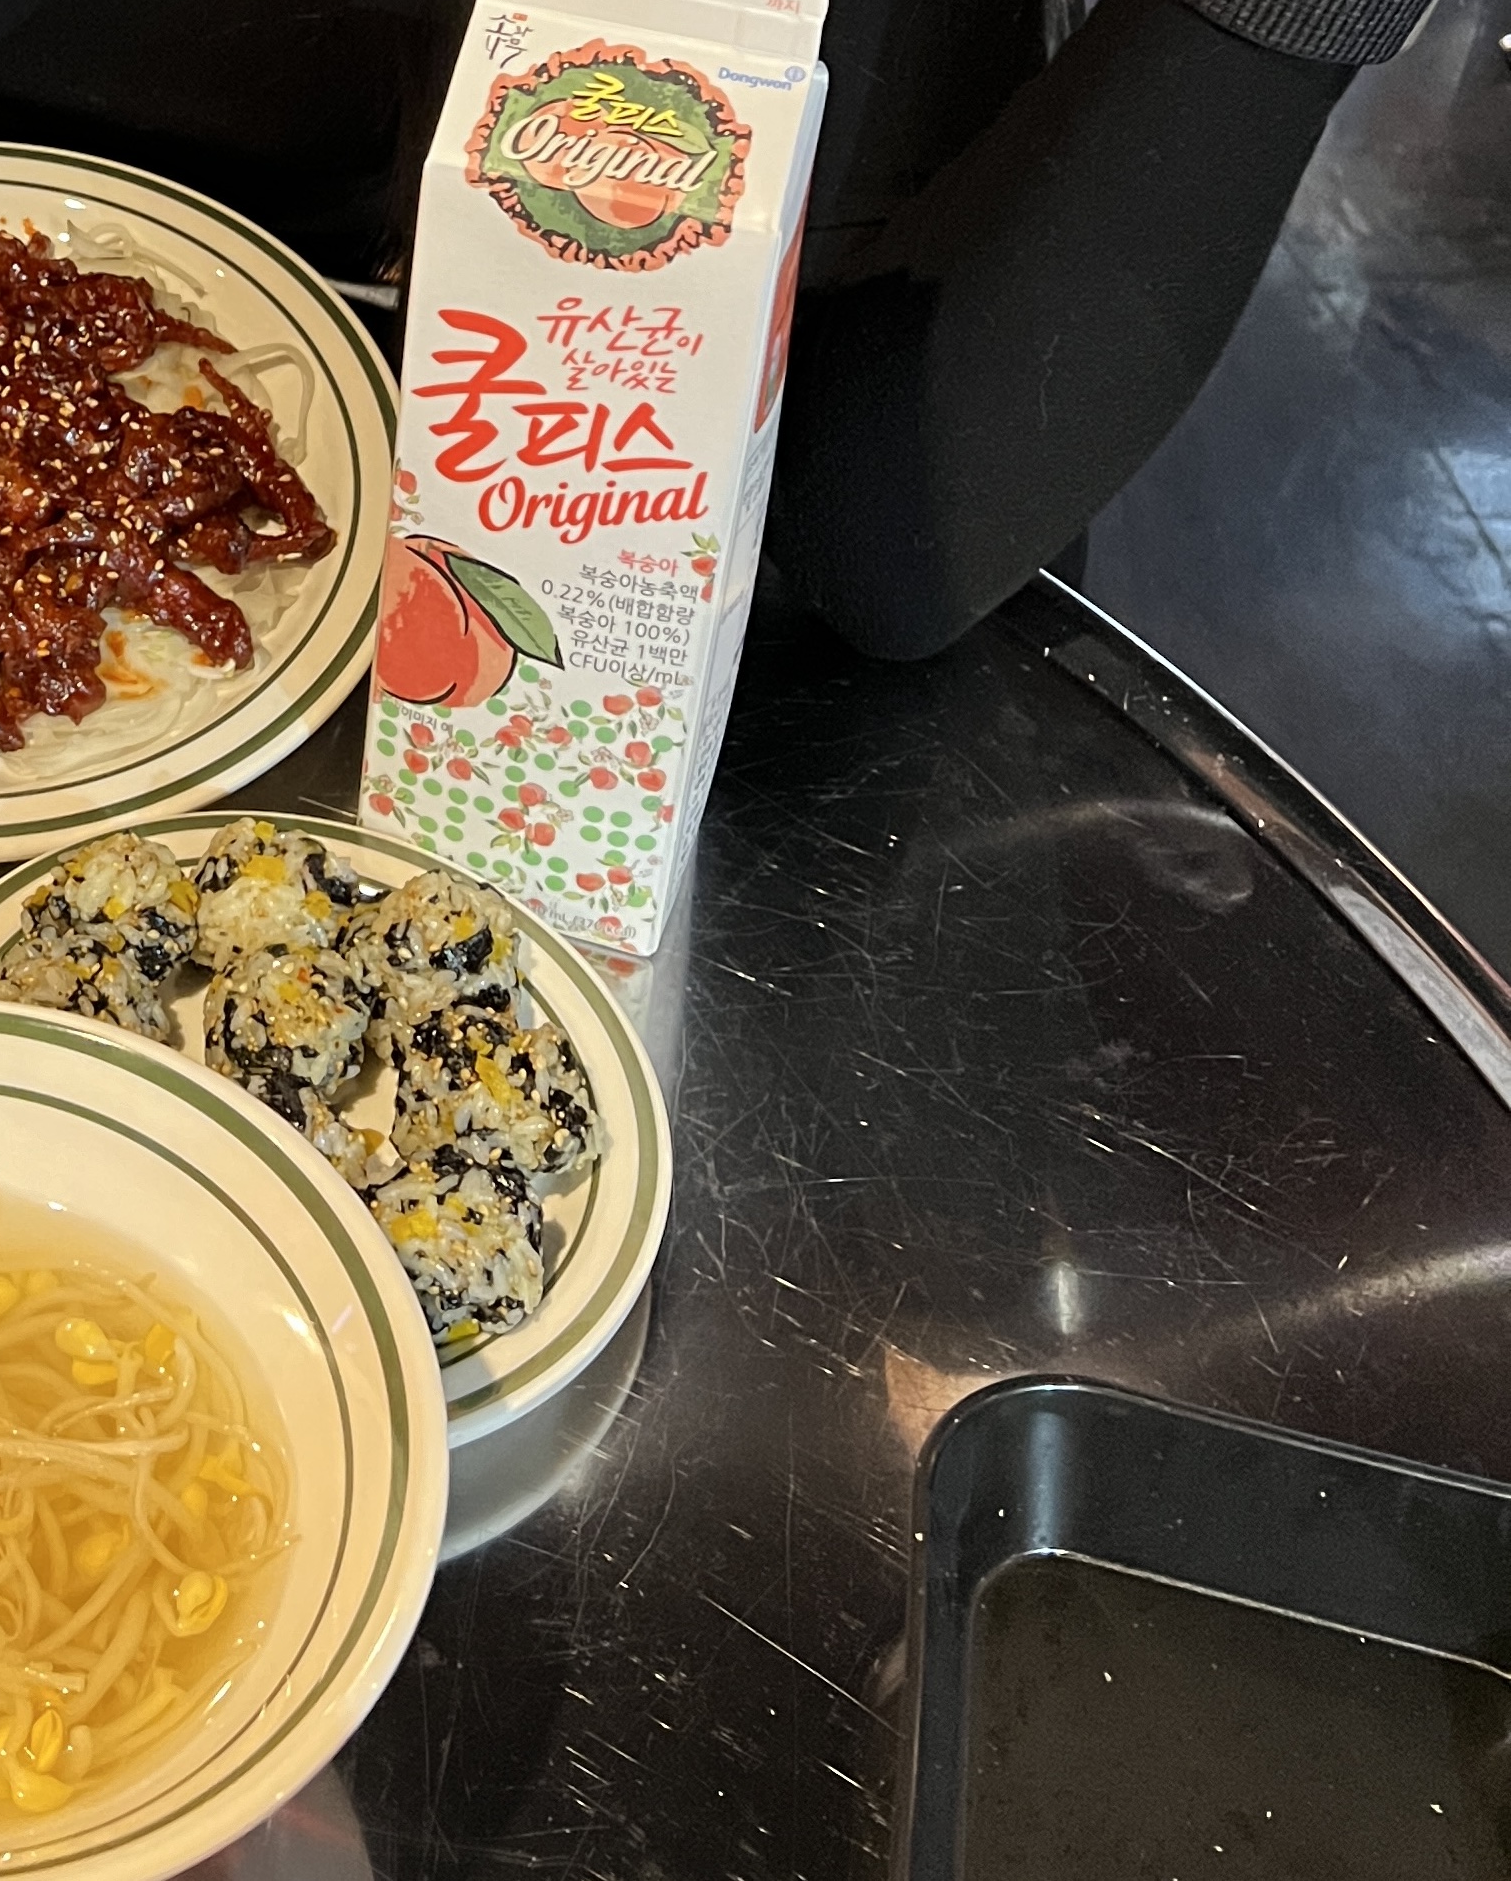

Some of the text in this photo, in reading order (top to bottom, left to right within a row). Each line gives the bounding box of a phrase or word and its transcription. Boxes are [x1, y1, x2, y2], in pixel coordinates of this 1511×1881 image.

[718, 67, 792, 91] Dongwon
[570, 72, 684, 137] 쿨피스
[500, 114, 718, 192] Original
[537, 297, 703, 356] 유산균이
[562, 347, 678, 394] 살아있는
[411, 309, 694, 483] 쿨피스
[478, 471, 709, 545] Original
[579, 564, 699, 604] 복숭아농축액
[617, 549, 679, 577] 복숭아
[557, 604, 690, 646] 복숭아 100%)
[569, 652, 683, 686] CFU이상/mL
[570, 629, 688, 667] 유산균 1백만
